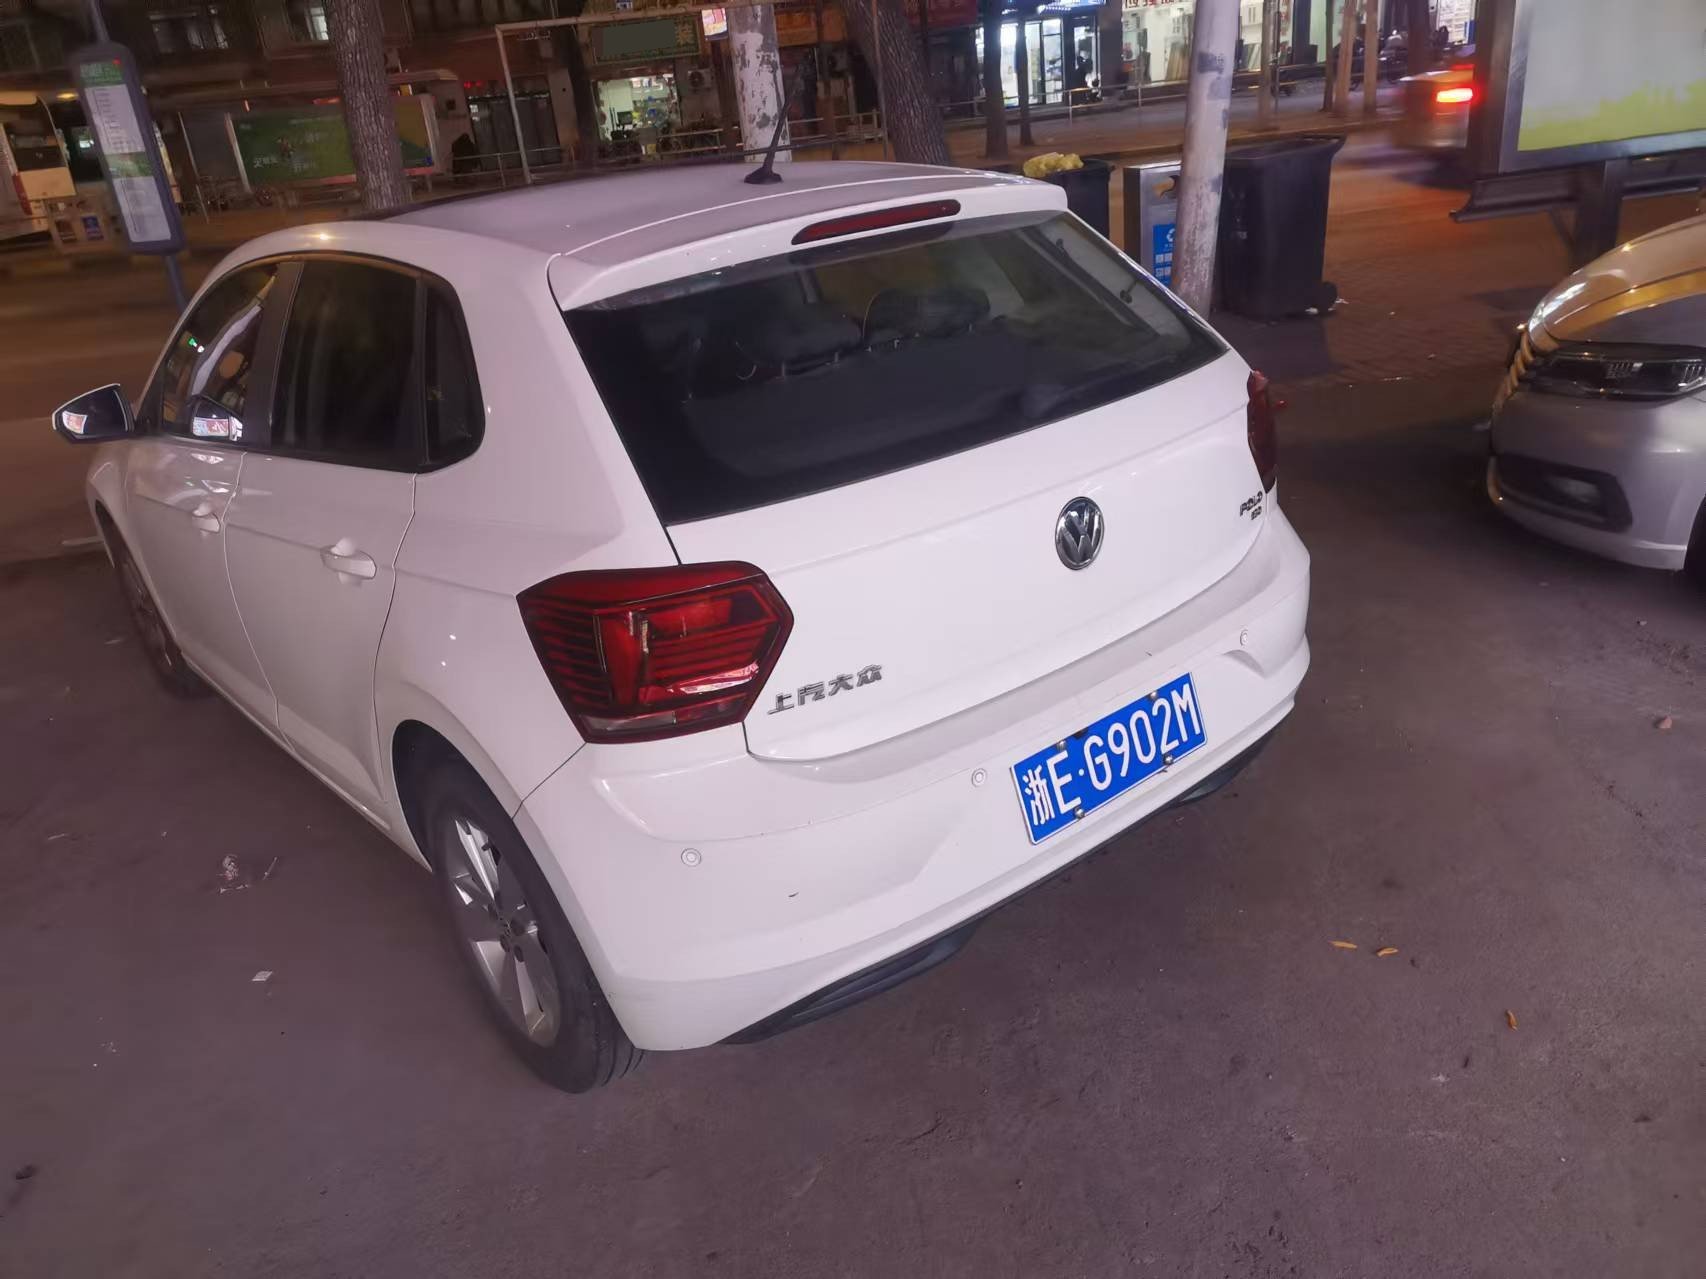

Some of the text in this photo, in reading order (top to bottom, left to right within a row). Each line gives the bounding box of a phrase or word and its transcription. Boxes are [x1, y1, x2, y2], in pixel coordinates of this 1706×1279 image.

[1239, 490, 1263, 517] POLO
[767, 664, 882, 715] 上汽大众
